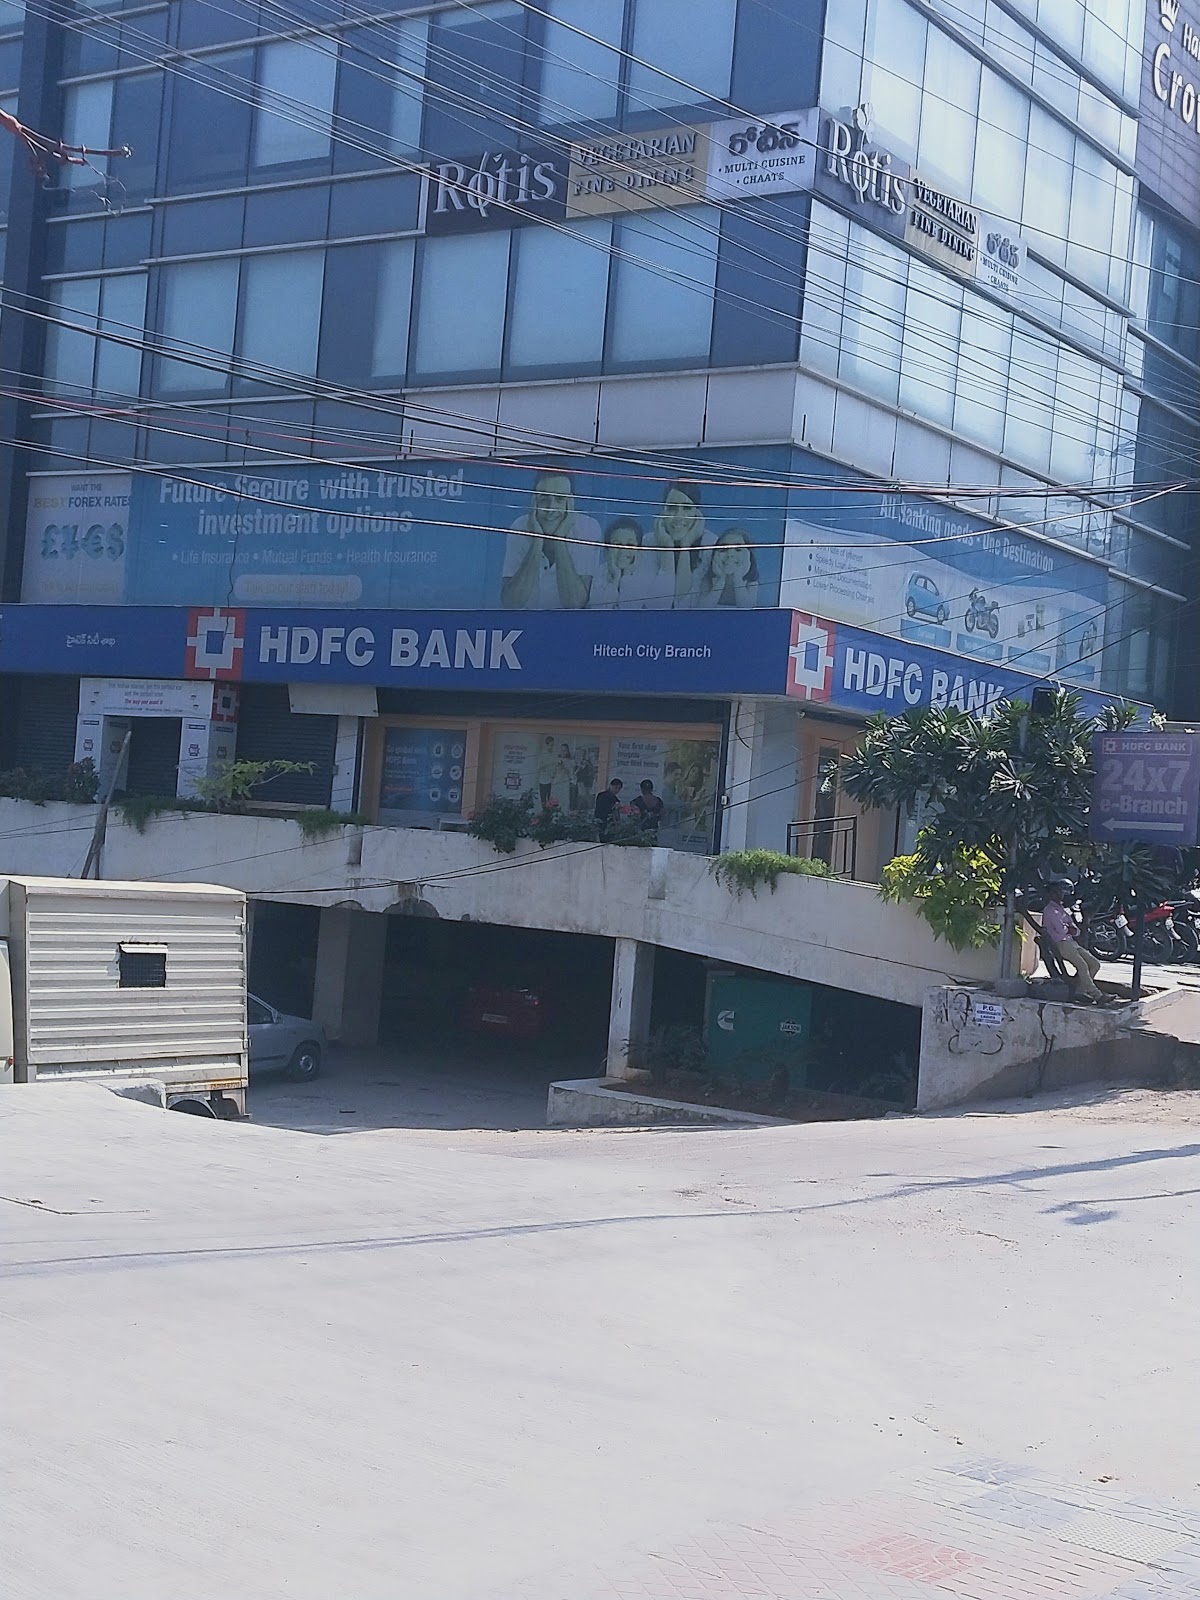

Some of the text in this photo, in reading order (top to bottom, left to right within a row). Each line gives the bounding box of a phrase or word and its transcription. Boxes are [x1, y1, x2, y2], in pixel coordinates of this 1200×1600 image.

[577, 132, 697, 165] VEGETARIAN
[724, 154, 806, 174] MULTI CUISINE
[827, 117, 905, 214] Rotis
[432, 151, 556, 217] Rotis
[573, 166, 695, 196] FINE DINING
[742, 171, 785, 185] CHAATS
[913, 180, 977, 235] VEGETARIAN
[911, 210, 976, 261] FINE DINING
[68, 496, 102, 508] FOREX
[159, 468, 464, 503] Future Secure with trusted
[198, 505, 414, 540] investment options
[880, 494, 898, 520] All
[900, 500, 941, 539] Banking
[944, 521, 974, 547] needs
[1002, 537, 1055, 573] Destination
[181, 548, 438, 565] Life Insurance Mutual Funds Health Insurance
[259, 625, 524, 670] HDFC BANK
[593, 644, 711, 661] Hitech City Branch
[843, 647, 1005, 720] HDFC BANK
[1121, 742, 1187, 751] HDFC BANK
[1100, 759, 1191, 793] 24x7
[1099, 794, 1188, 816] e-Branch
